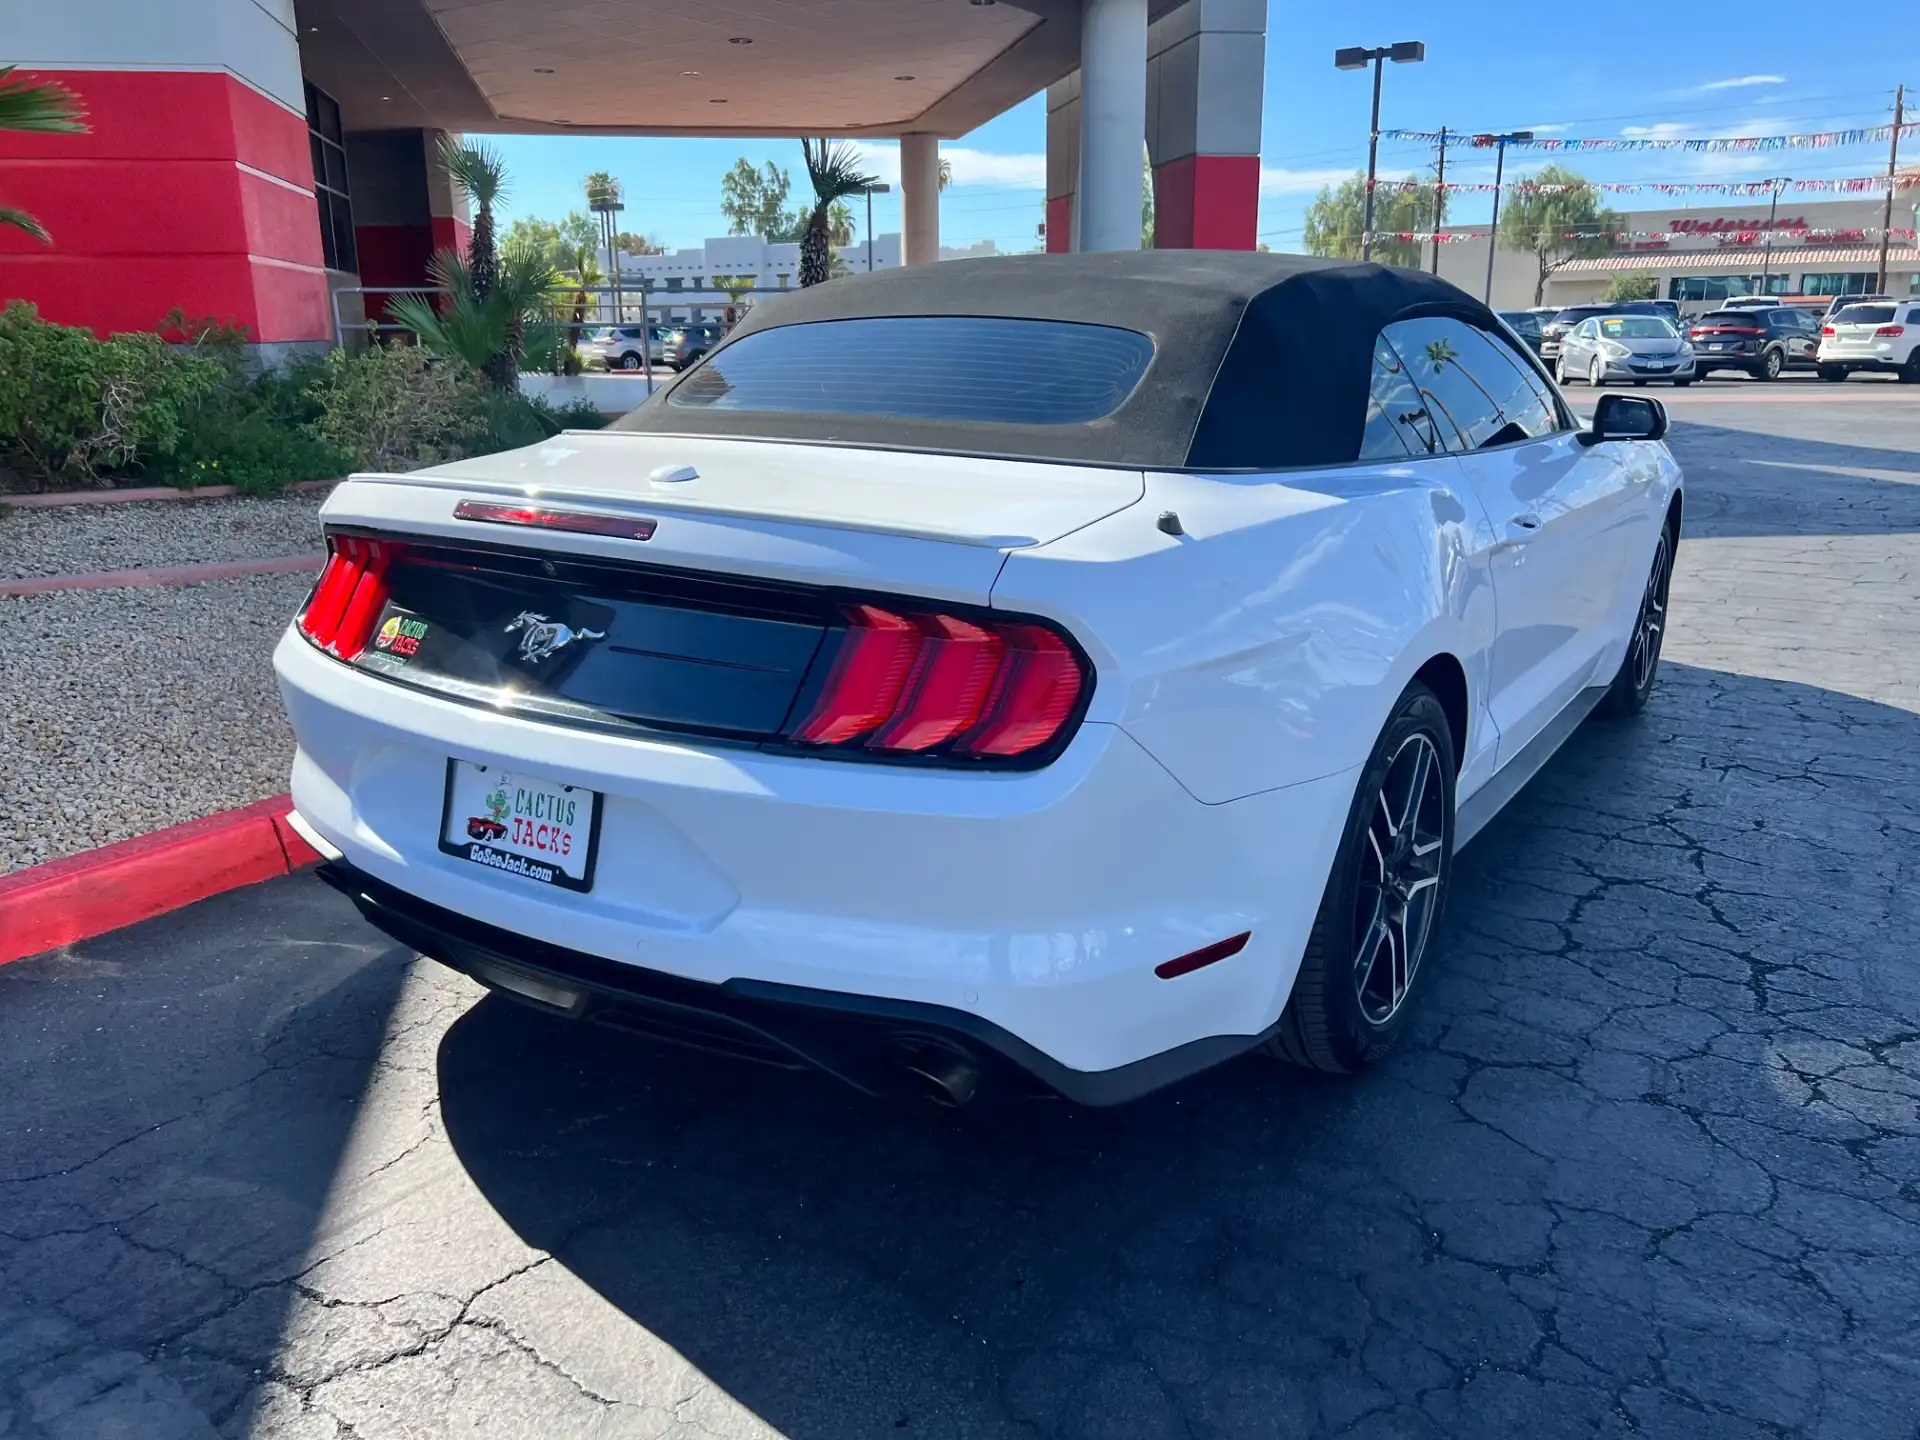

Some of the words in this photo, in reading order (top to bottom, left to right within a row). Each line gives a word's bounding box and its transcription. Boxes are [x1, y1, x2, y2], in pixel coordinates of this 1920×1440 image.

[1669, 216, 1809, 234] Walgreens
[399, 618, 428, 640] CACTUS
[515, 788, 576, 826] CACTUS
[470, 844, 553, 882] GoSeeJack.com
